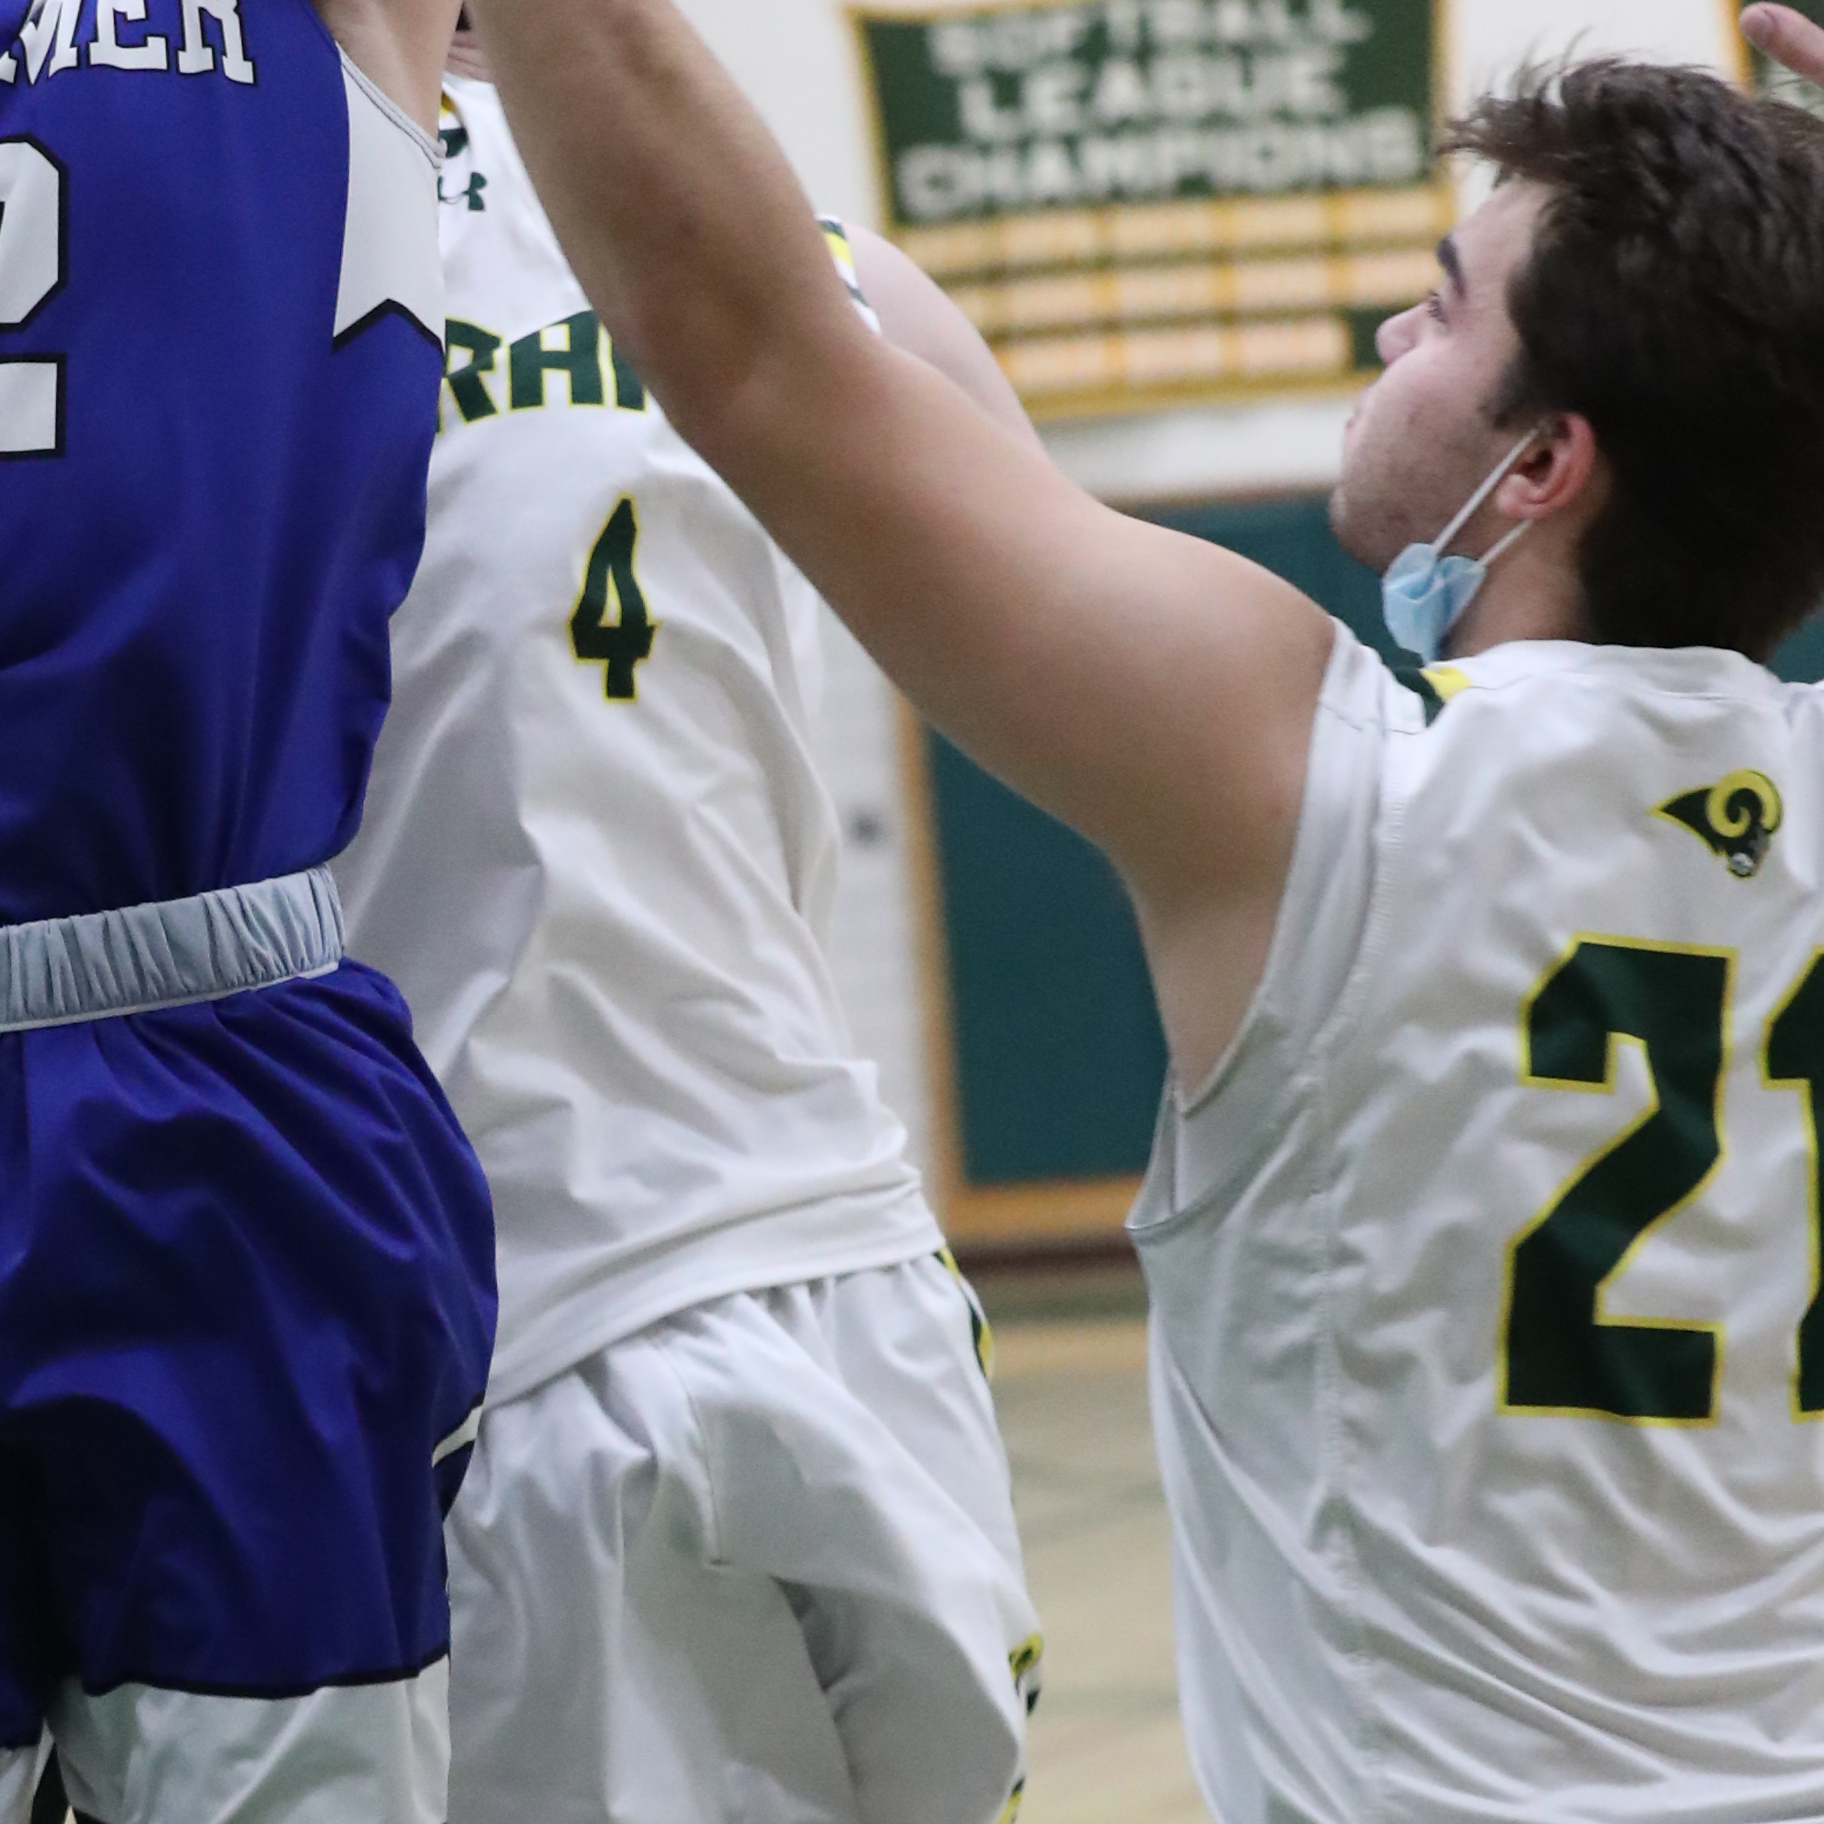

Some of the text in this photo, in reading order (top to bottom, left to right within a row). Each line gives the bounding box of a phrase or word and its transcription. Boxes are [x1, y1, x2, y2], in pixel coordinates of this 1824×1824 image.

[958, 46, 1345, 140] LEAGUE
[898, 106, 1421, 221] CHAMPIONS
[569, 493, 657, 703] 4
